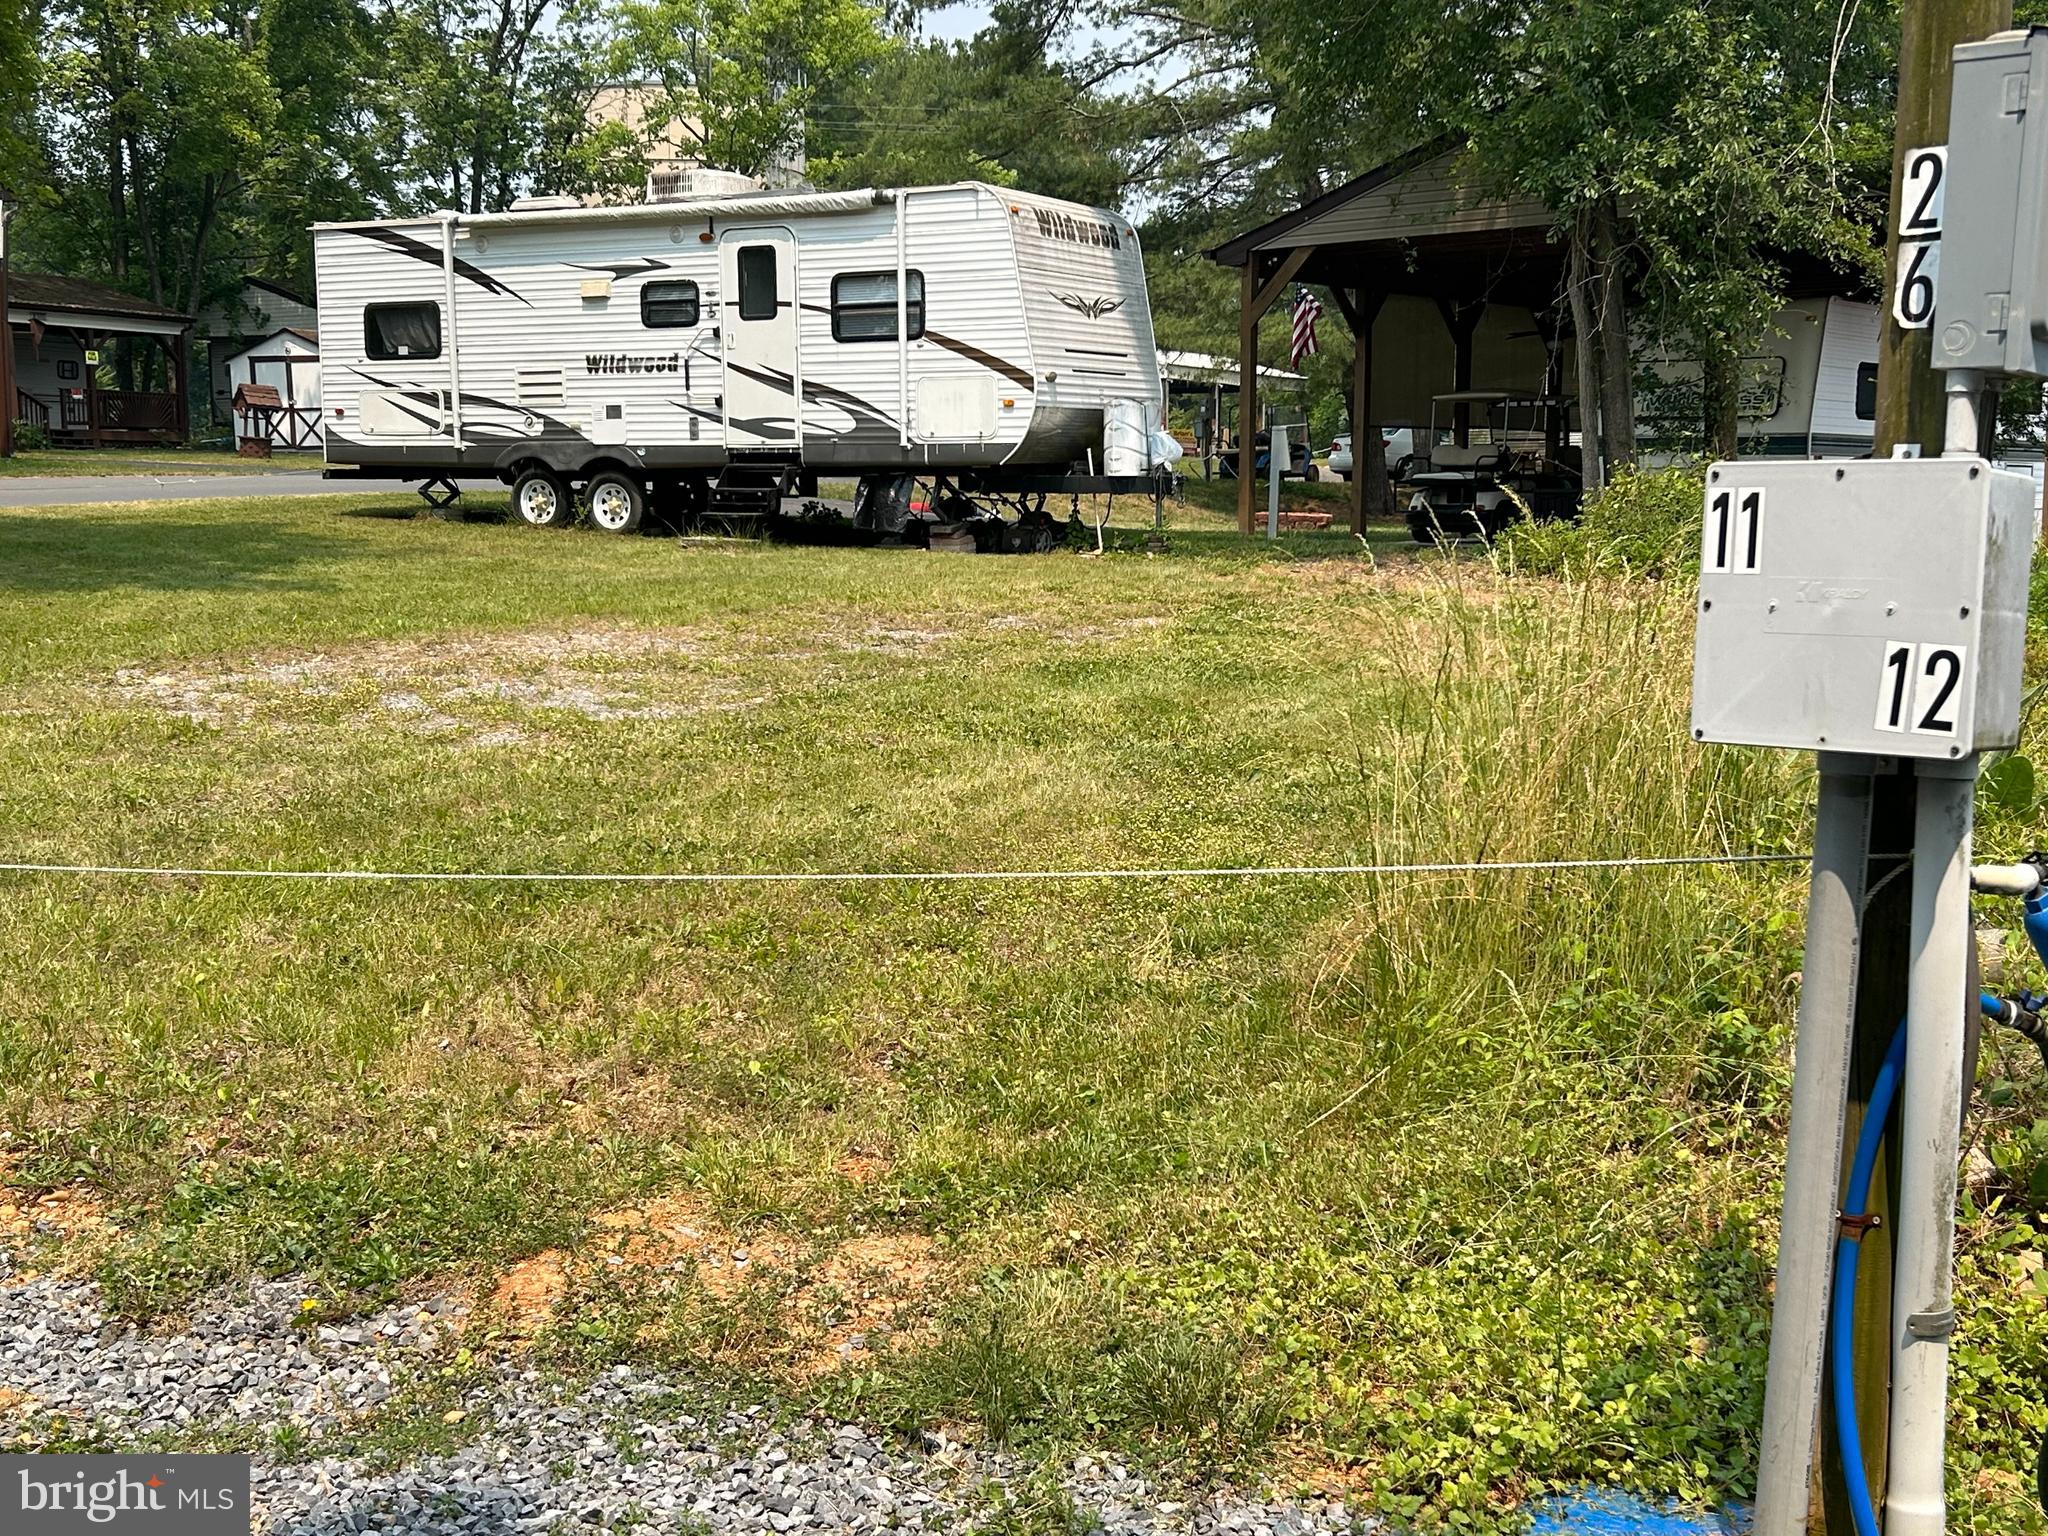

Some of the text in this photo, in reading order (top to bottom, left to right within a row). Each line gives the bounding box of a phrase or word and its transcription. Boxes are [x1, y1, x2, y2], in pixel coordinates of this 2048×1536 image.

[1032, 206, 1122, 250] Wildwood
[586, 353, 679, 375] Wildwood
[1711, 492, 1760, 569] 11
[1887, 647, 1961, 732] 12
